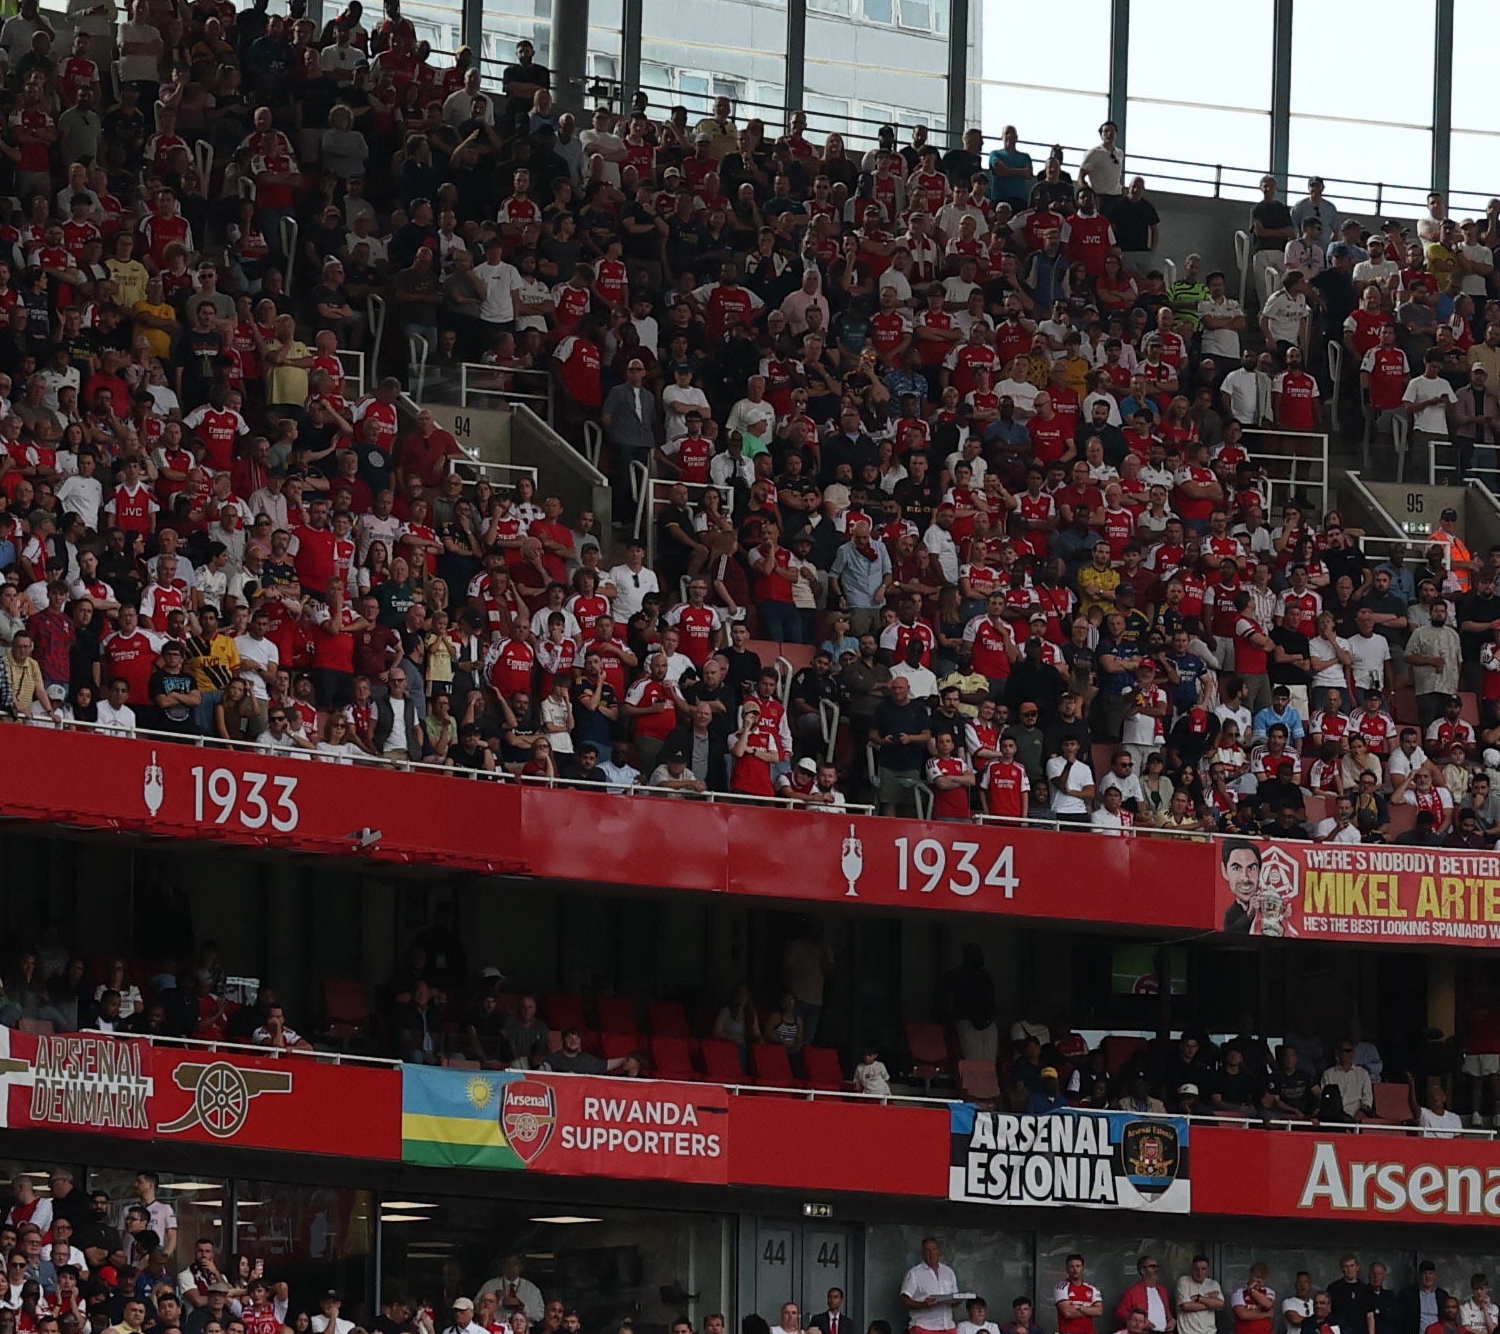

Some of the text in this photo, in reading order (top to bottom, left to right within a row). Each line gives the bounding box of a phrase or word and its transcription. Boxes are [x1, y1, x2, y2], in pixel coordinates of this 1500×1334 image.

[455, 415, 471, 437] 94
[1407, 493, 1424, 513] 95
[193, 765, 299, 833] 1933
[895, 836, 1020, 900] 1934
[1303, 848, 1367, 870] THERE'S
[1369, 851, 1435, 874] NOBODY
[1304, 871, 1407, 918] MIKEL
[1303, 917, 1328, 933] HE'S
[1330, 918, 1349, 934] THE
[1351, 920, 1379, 935] BEST
[1381, 921, 1431, 937] LOOKING
[1432, 923, 1487, 940] SPANIARD
[36, 1034, 148, 1086] ARSENAL
[30, 1077, 149, 1130] DENMARK
[505, 1092, 549, 1109] Arsenal
[583, 1096, 699, 1127] RWANDA
[560, 1125, 721, 1158] SUPPORTERS
[969, 1110, 1115, 1158] ARSENAL
[966, 1151, 1118, 1204] ESTONIA
[763, 1239, 841, 1269] 44 44
